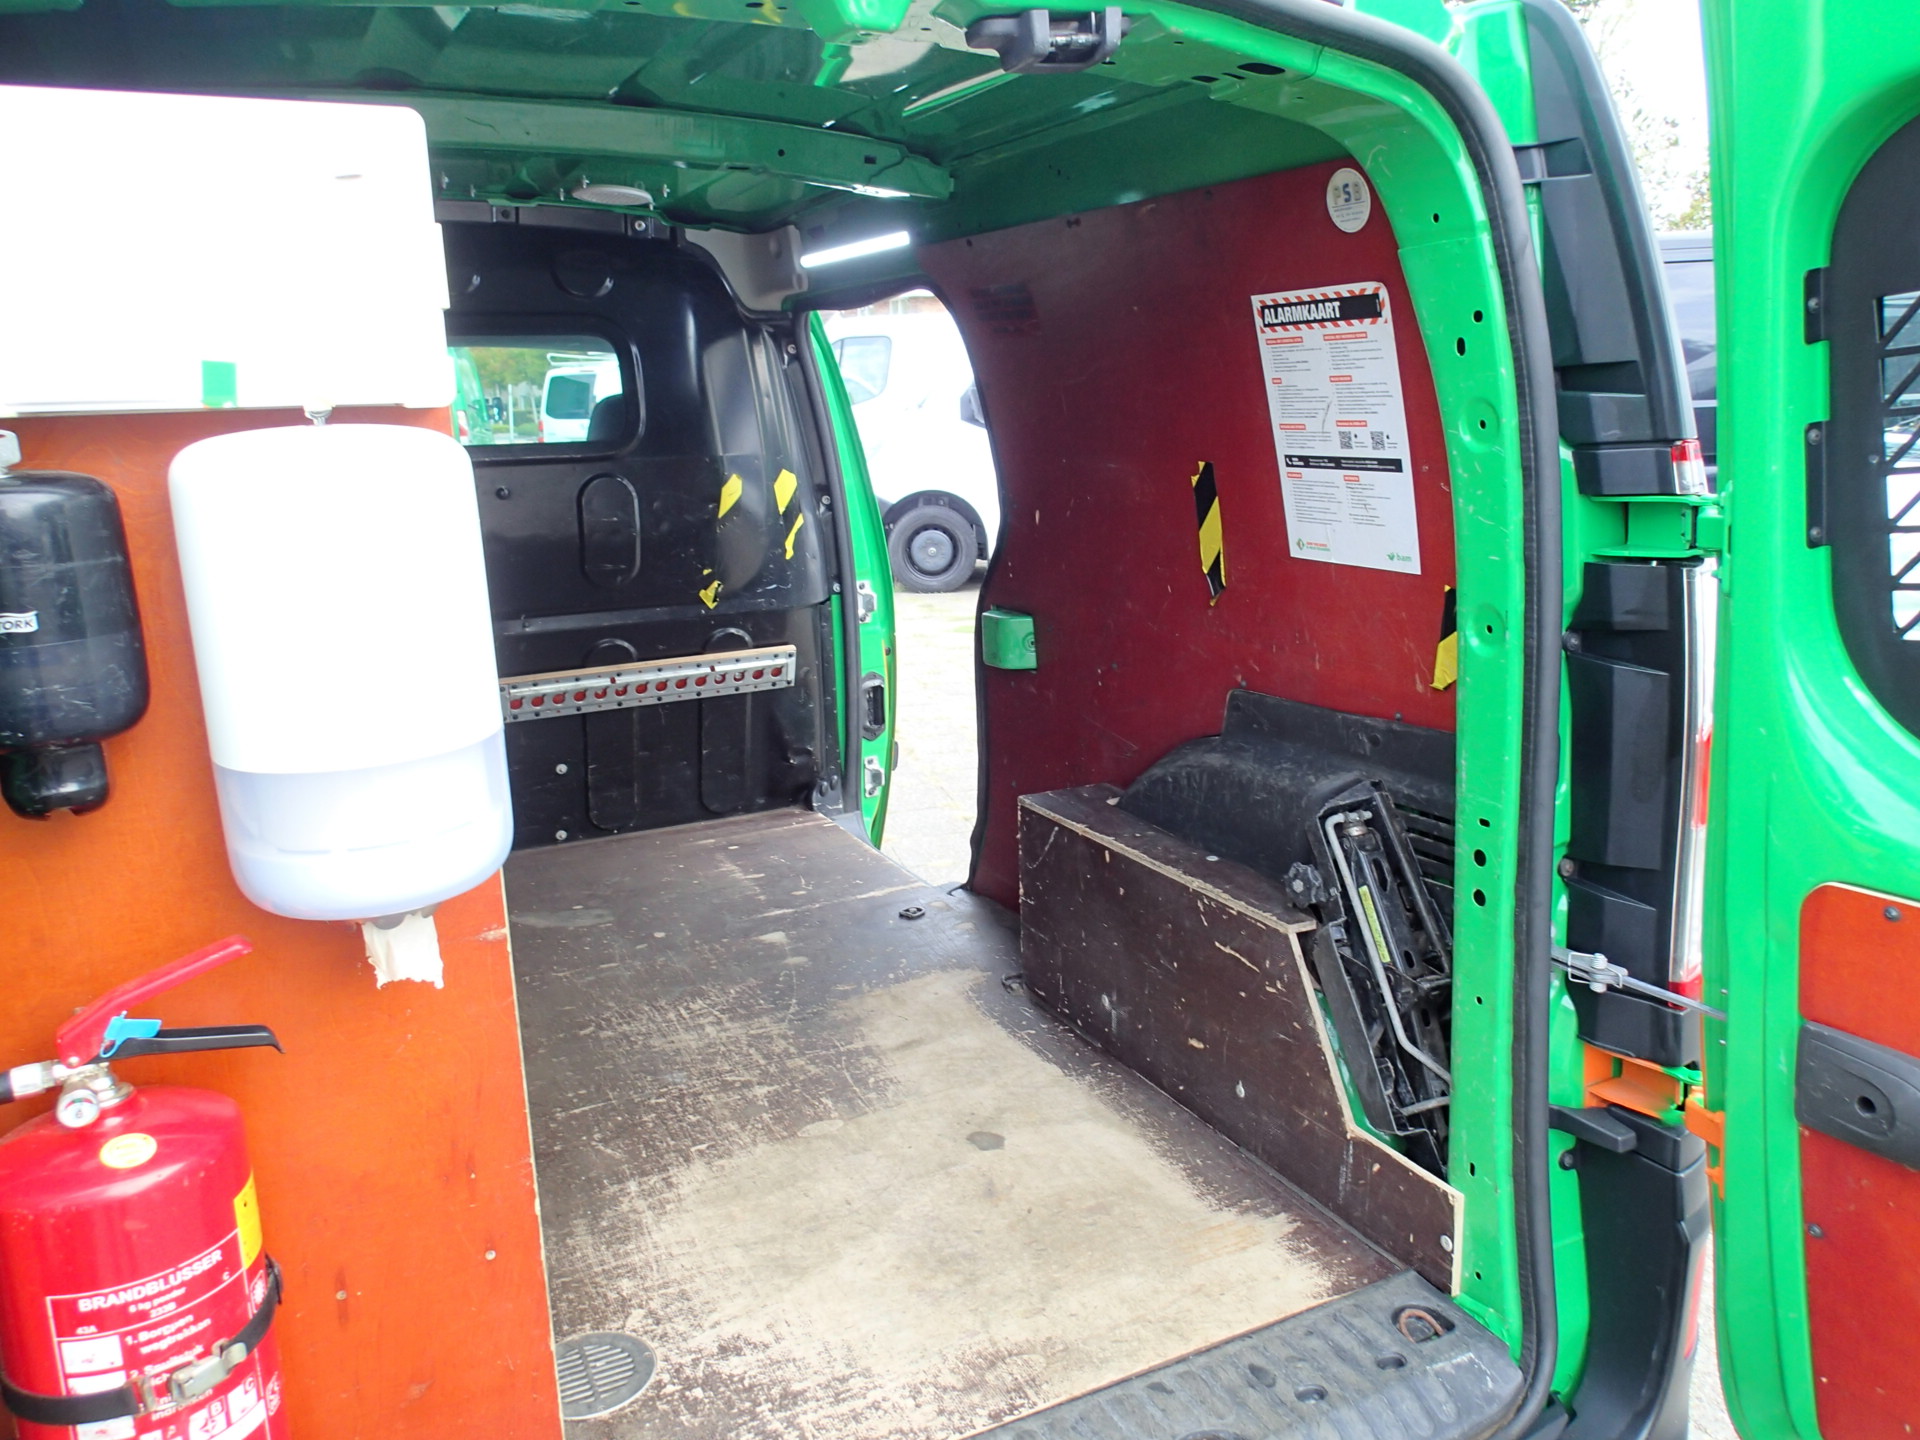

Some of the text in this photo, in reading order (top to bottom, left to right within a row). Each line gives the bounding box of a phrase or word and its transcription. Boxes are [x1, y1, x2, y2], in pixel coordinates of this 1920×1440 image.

[1263, 301, 1341, 325] ALARMKAART
[0, 619, 34, 631] ORK
[78, 1249, 223, 1312] BRANDBLUSSER
